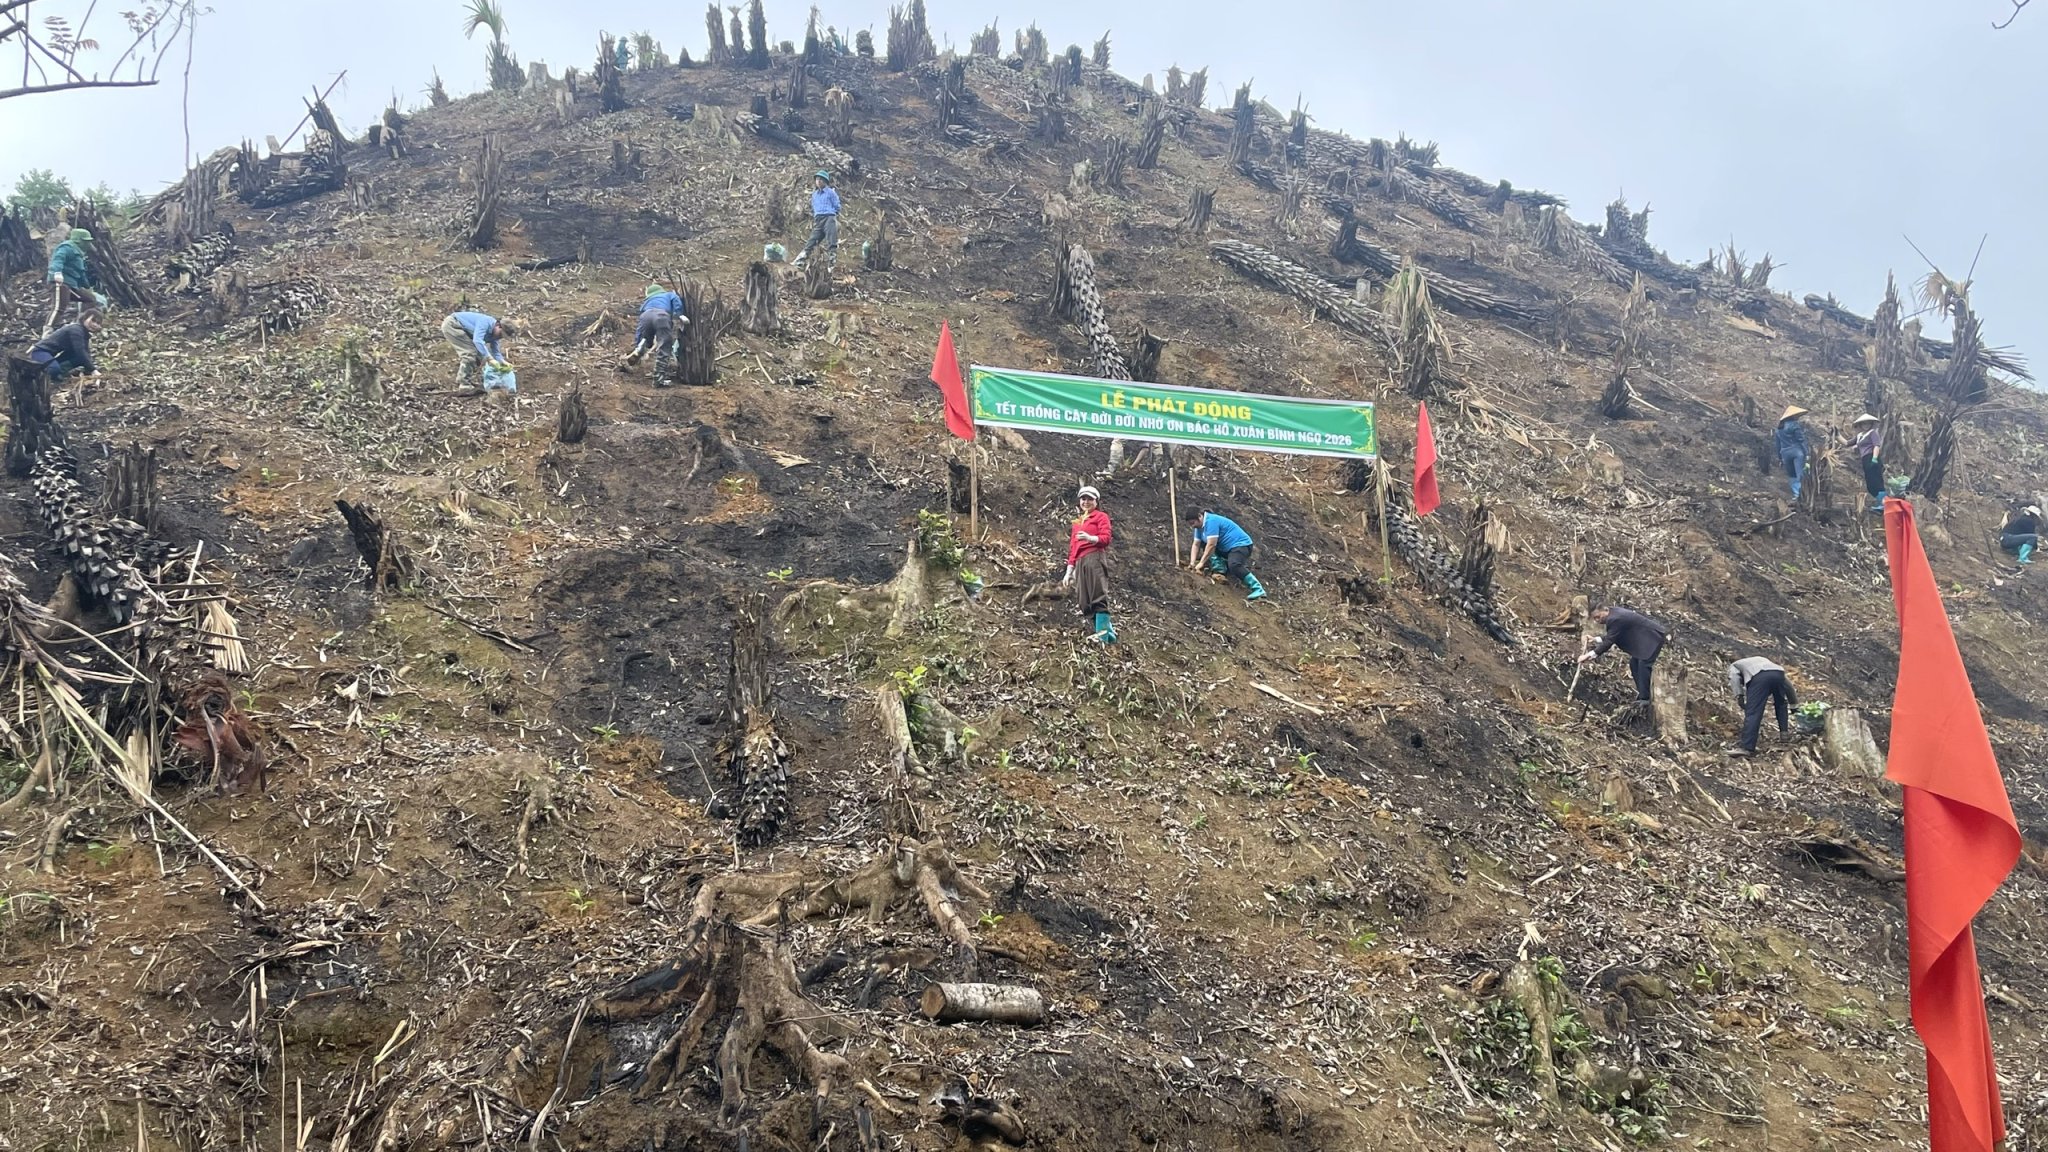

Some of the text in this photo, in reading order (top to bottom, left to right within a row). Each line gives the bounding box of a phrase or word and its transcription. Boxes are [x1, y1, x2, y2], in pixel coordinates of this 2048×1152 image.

[995, 400, 1352, 446] TẾT TRỒNG CÂY ĐỜI ĐỜI NHỚ ƠN BÁC HỒ XUÂN BÌNH NGỌ 2026
[1101, 390, 1252, 420] LỄ PHÁT ĐỘNG
